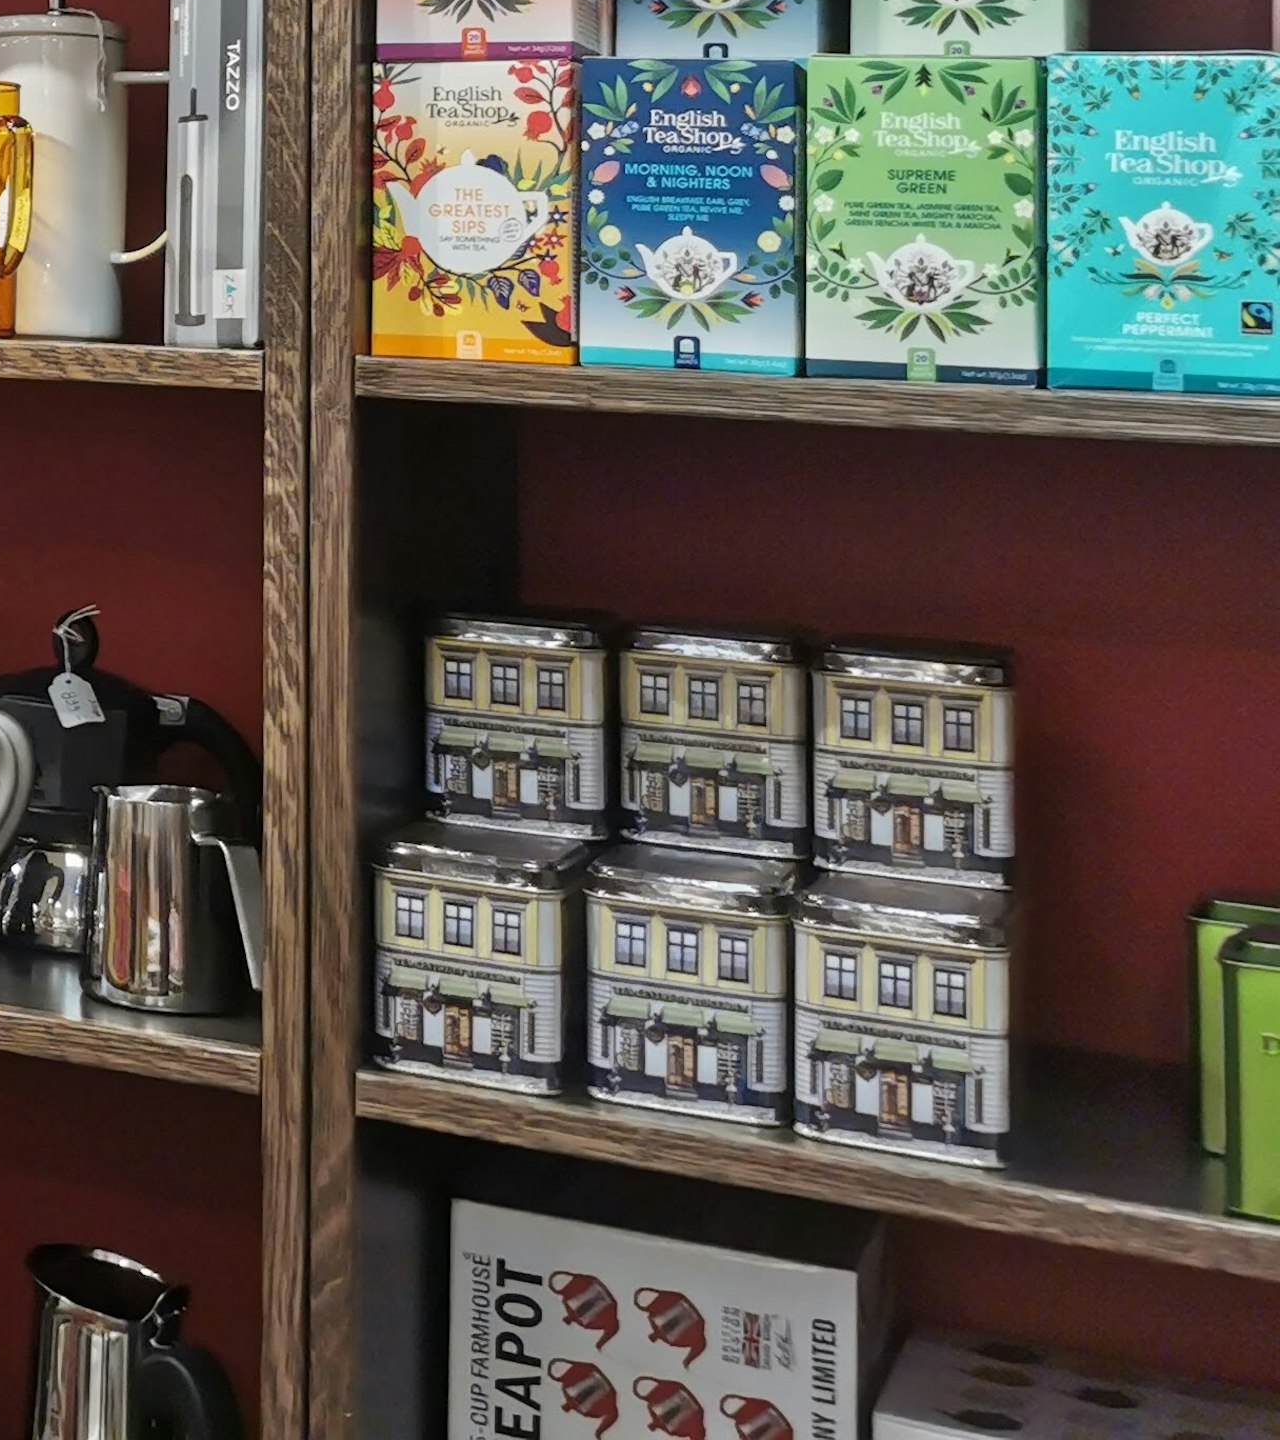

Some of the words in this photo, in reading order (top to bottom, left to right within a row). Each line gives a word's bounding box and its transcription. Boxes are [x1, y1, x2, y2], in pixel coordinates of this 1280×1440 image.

[224, 39, 241, 113] TAZZO
[624, 162, 701, 178] MORNING,
[704, 164, 754, 178] NOON
[887, 169, 957, 183] SUPREME
[646, 178, 657, 189] &
[660, 177, 732, 191] NIGHTERS
[896, 182, 948, 195] GREEN
[454, 188, 483, 202] THE
[428, 203, 511, 220] GREATEST
[451, 221, 487, 235] SIPS
[1136, 312, 1200, 327] PERFECT
[1122, 323, 1214, 340] PEPPERMINT
[470, 1254, 492, 1380] FARMHOUSE
[495, 1257, 543, 1440] EAPOT
[811, 1318, 838, 1405] LIMITED
